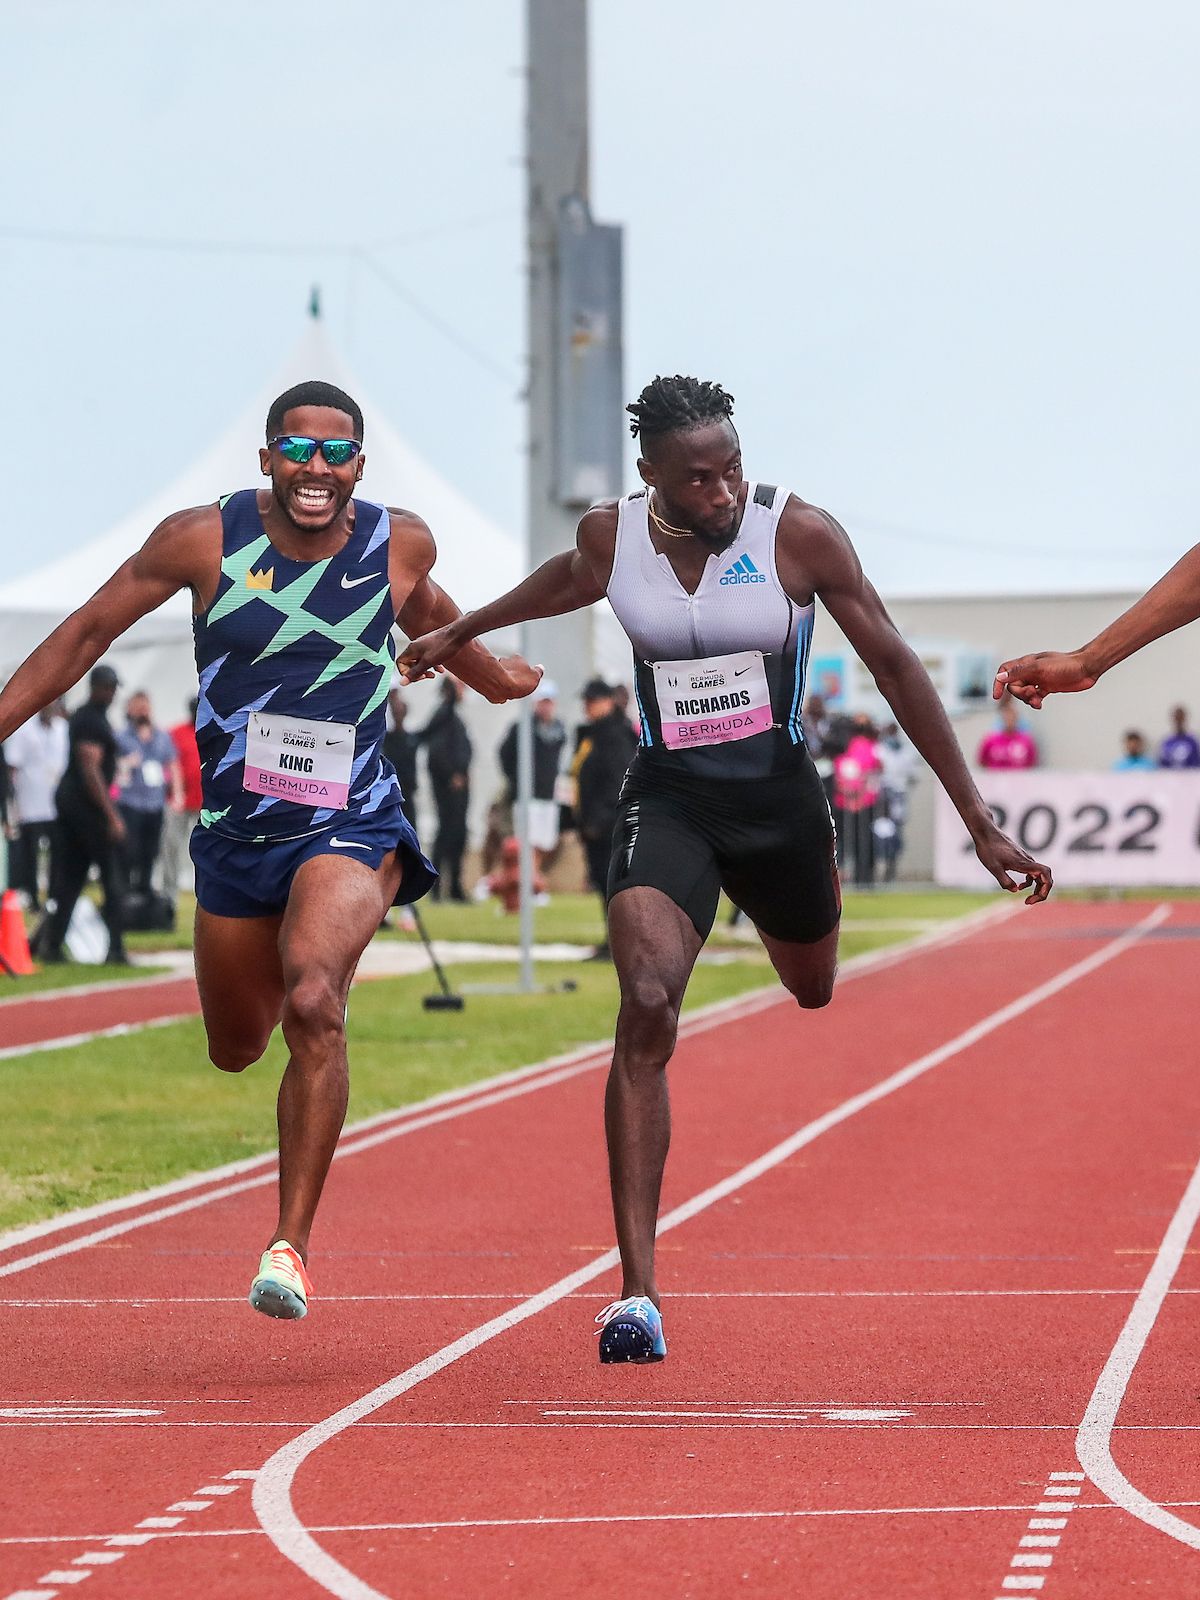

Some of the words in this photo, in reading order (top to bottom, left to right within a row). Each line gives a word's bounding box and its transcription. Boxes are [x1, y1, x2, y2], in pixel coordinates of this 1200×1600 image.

[719, 573, 766, 585] adidas
[691, 678, 725, 689] GAMES
[674, 690, 751, 716] RICHARDS
[678, 716, 754, 737] BERMUDA
[282, 737, 316, 749] GAMES
[278, 753, 314, 773] KING
[259, 773, 329, 795] BERMUDA
